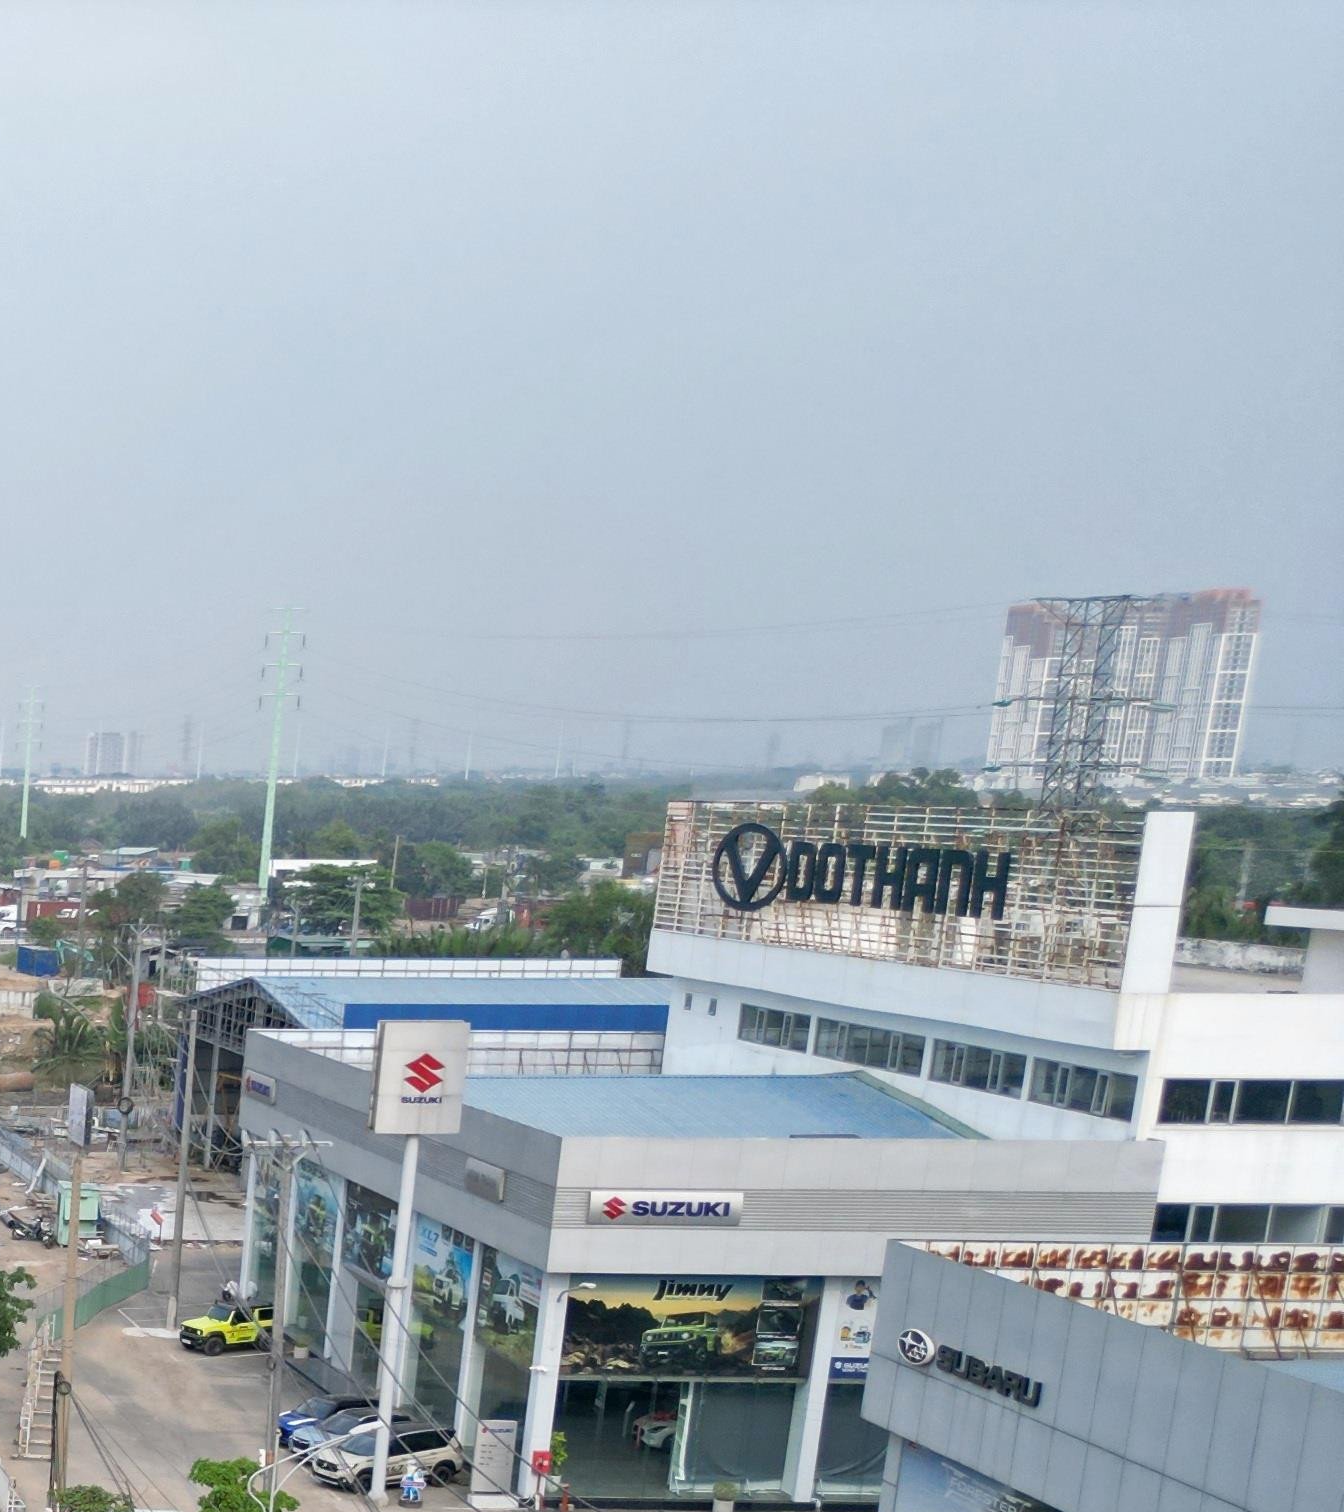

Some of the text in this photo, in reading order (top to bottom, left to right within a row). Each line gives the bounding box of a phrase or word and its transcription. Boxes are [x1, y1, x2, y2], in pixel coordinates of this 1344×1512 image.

[401, 1096, 442, 1104] SUZUKI
[631, 1200, 731, 1217] SUZUKI
[653, 1280, 733, 1302] Jimny
[936, 1345, 1043, 1408] SUBARU
